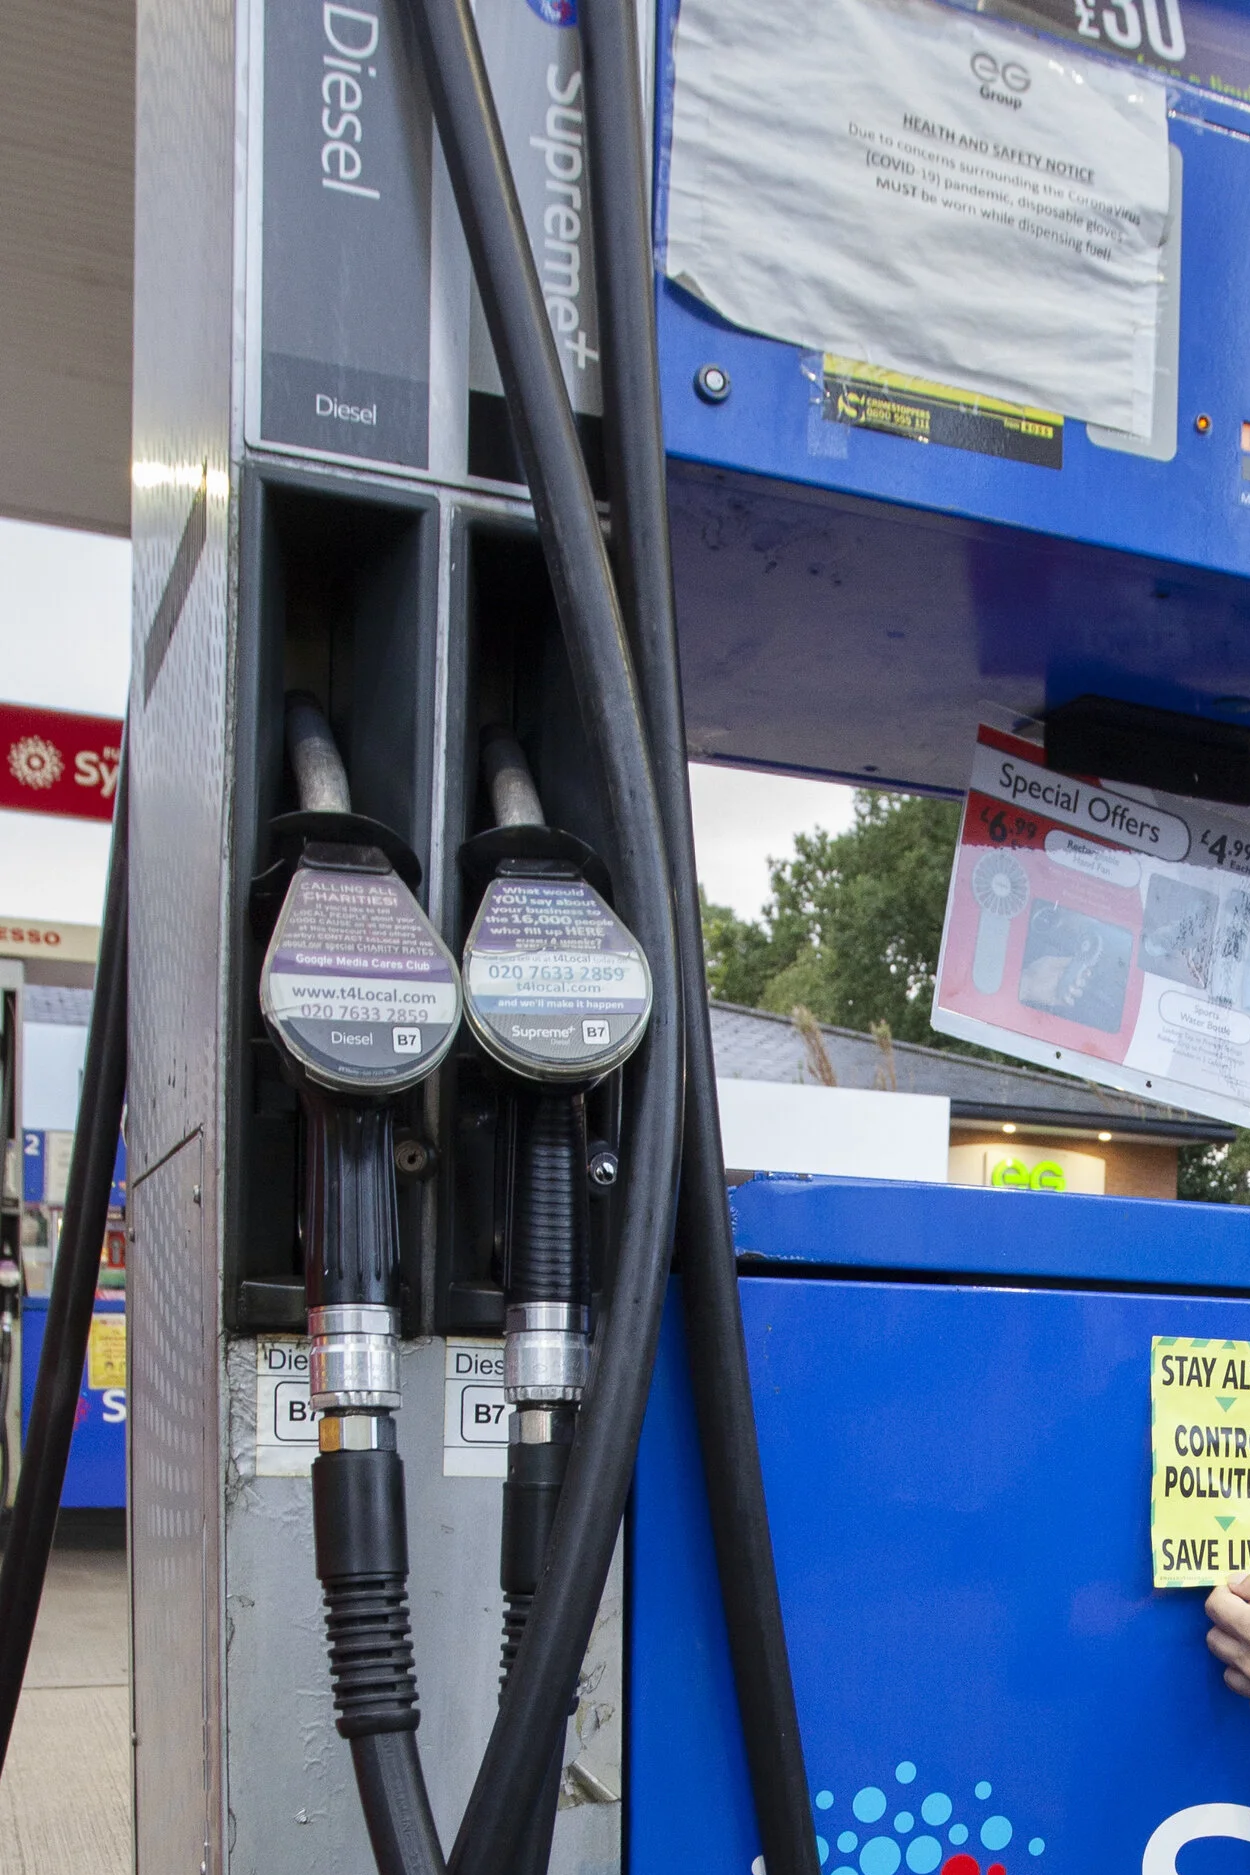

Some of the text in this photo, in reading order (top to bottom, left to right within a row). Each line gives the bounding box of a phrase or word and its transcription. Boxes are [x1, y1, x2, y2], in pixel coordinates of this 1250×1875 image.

[322, 2, 380, 199] Diesel
[980, 85, 1022, 109] Group
[903, 112, 1096, 184] HEALTH AND SAFETY NOTICE
[849, 122, 1142, 226] Due to concerns surrounding the CoronaVirus
[875, 176, 917, 198] MUST
[921, 189, 938, 204] be
[942, 199, 976, 216] worn
[980, 206, 1015, 227] while
[1018, 217, 1083, 253] dispensing
[944, 176, 1014, 207] pandemic,
[1018, 196, 1083, 228] disposable
[1086, 219, 1124, 244] gloves
[316, 393, 377, 427] Diesel
[1000, 762, 1161, 845] Special Offers
[980, 805, 1038, 843] £6.99
[1230, 858, 1250, 875] Each
[300, 881, 397, 897] CALLING ALL
[502, 886, 585, 898] What would
[303, 891, 398, 908] CHARITIES!
[492, 895, 598, 908] YOU say about
[484, 913, 615, 928] the 16,000 people
[491, 905, 602, 917] your business to
[489, 926, 606, 938] who fill up HERE
[295, 953, 431, 972] Google Media Cares Club
[488, 964, 626, 982] 020 7633 2859
[292, 985, 437, 1005] www.t4Local.com
[498, 999, 625, 1011] and we'll make it happen
[300, 1003, 429, 1024] 020 7633 2859
[1180, 1011, 1205, 1027] Water
[331, 1030, 417, 1047] Diesel B7
[511, 1024, 576, 1040] Supreme+
[586, 1026, 606, 1039] B7
[24, 1133, 40, 1157] 2
[267, 1348, 310, 1371] Die
[455, 1352, 505, 1375] Dies
[1161, 1354, 1217, 1388] STAY
[474, 1404, 506, 1425] B7
[1161, 1537, 1220, 1571] SAVE
